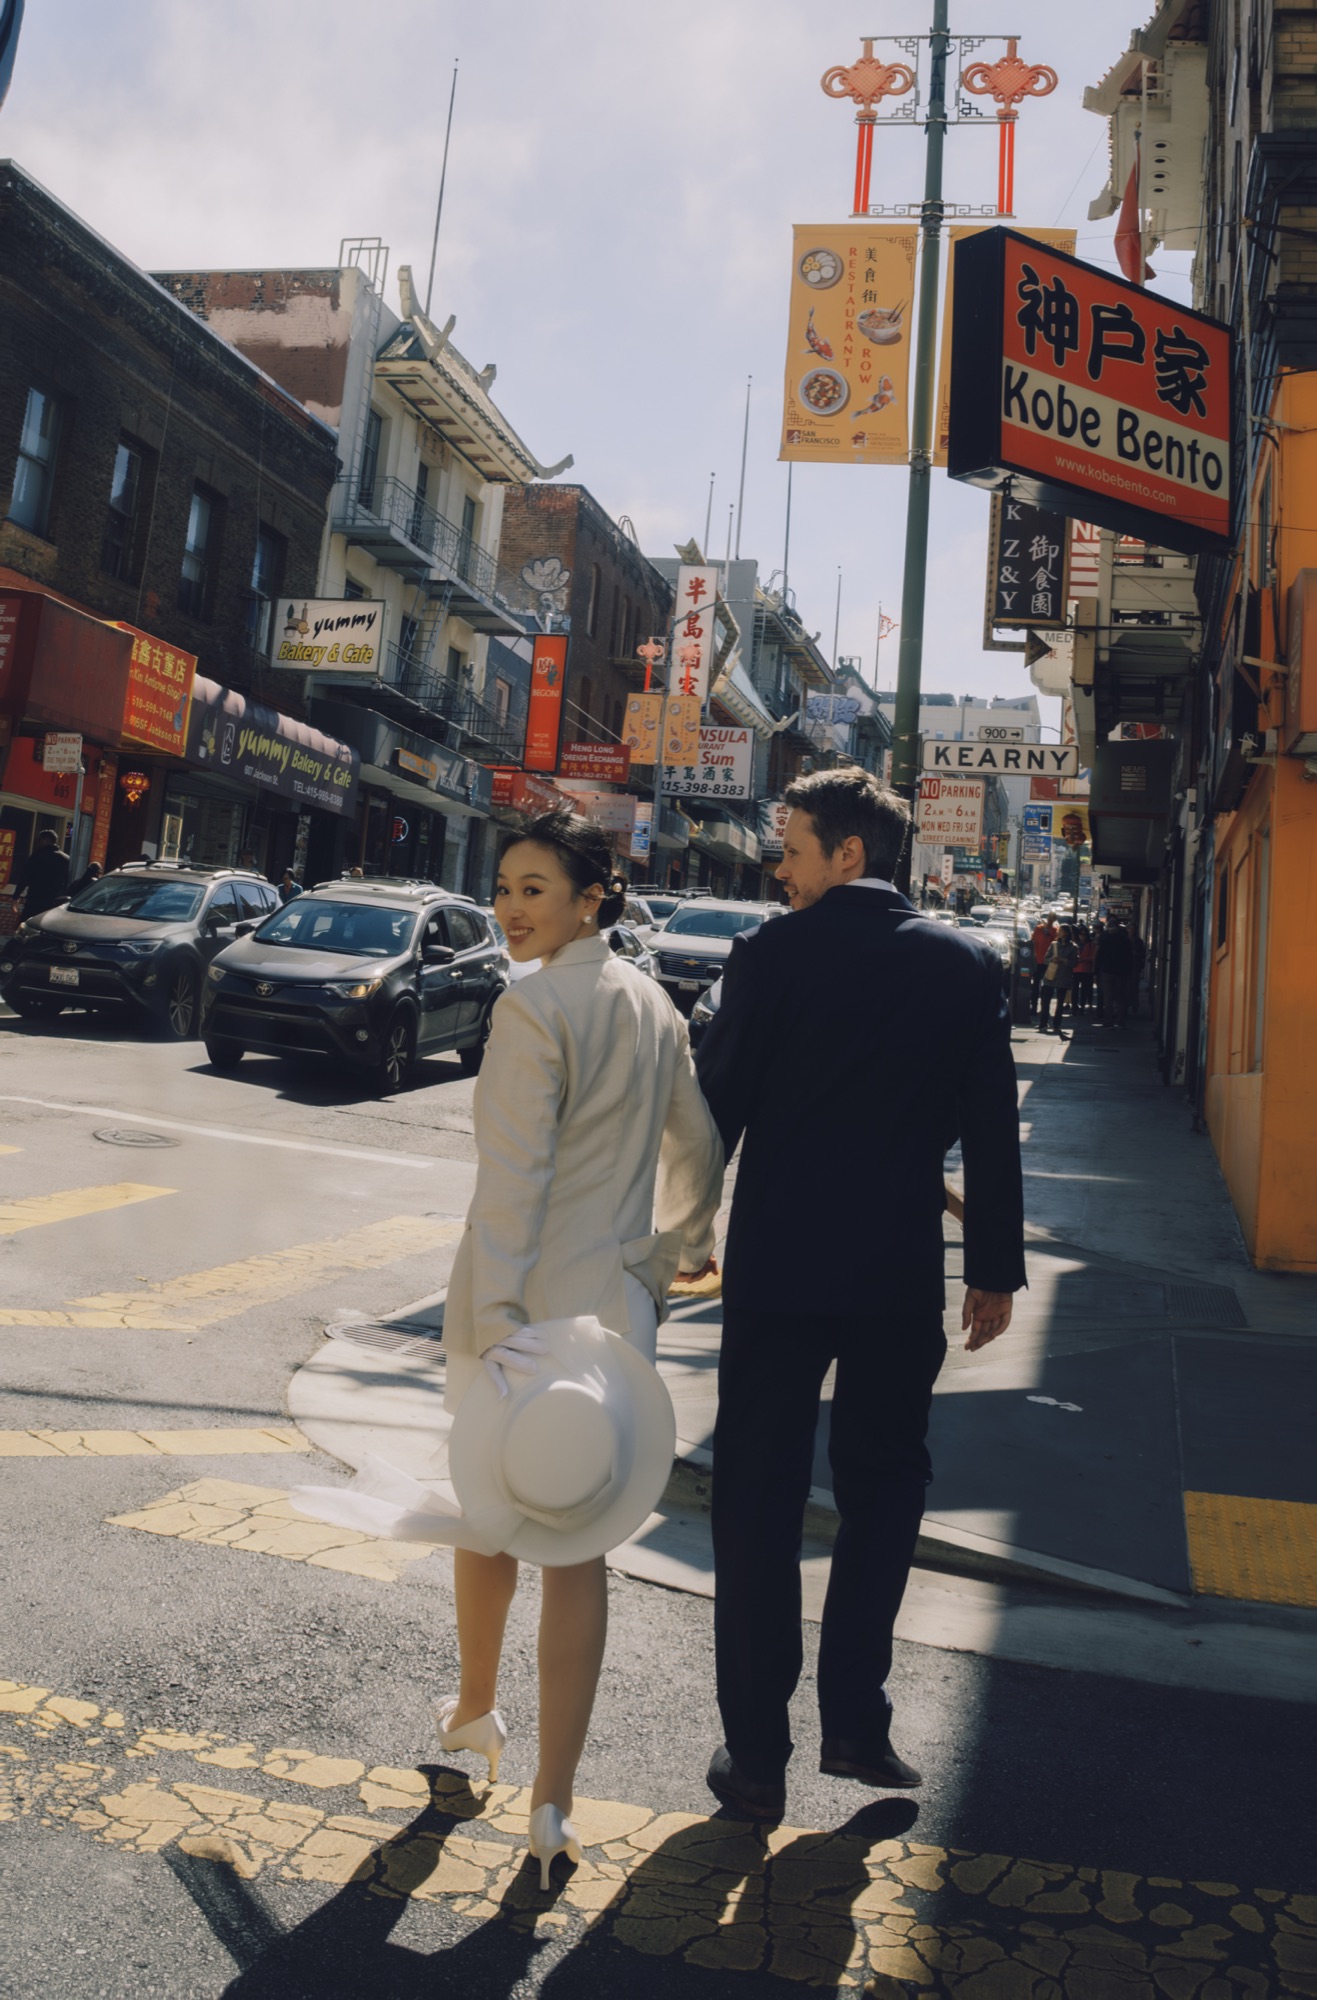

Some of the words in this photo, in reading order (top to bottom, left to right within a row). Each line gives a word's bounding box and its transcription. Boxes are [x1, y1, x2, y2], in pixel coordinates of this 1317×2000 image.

[860, 247, 878, 304] 美食街
[843, 247, 857, 368] RESTAURANT
[858, 348, 873, 384] ROW
[1003, 364, 1100, 448] Kobe
[1117, 407, 1223, 491] Bento
[801, 437, 840, 445] FRANCISCO
[1054, 455, 1176, 507] www.kobebento.com
[1028, 534, 1060, 617] 御食園
[313, 611, 377, 640] yummy
[278, 641, 328, 667] Bakery
[328, 643, 340, 663] &
[342, 643, 374, 664] Cafe
[47, 735, 56, 744] NO
[57, 735, 81, 744] PARKING
[699, 729, 748, 744] NSULA
[984, 728, 1007, 738] 900
[237, 728, 291, 774] yummy
[291, 749, 322, 781] Bakery
[324, 762, 333, 781] &
[333, 766, 352, 788] Cafe
[701, 751, 735, 767] Sum
[935, 746, 1069, 771] KEARNY
[1121, 765, 1146, 773] NEMS
[921, 780, 939, 798] NO
[941, 785, 981, 799] PARKING
[924, 803, 932, 816] 2
[956, 805, 963, 817] 6
[921, 821, 935, 831] MON
[937, 821, 950, 832] WED
[952, 822, 963, 832] FRI
[964, 822, 977, 833] SAT
[945, 835, 975, 843] CLEANING
